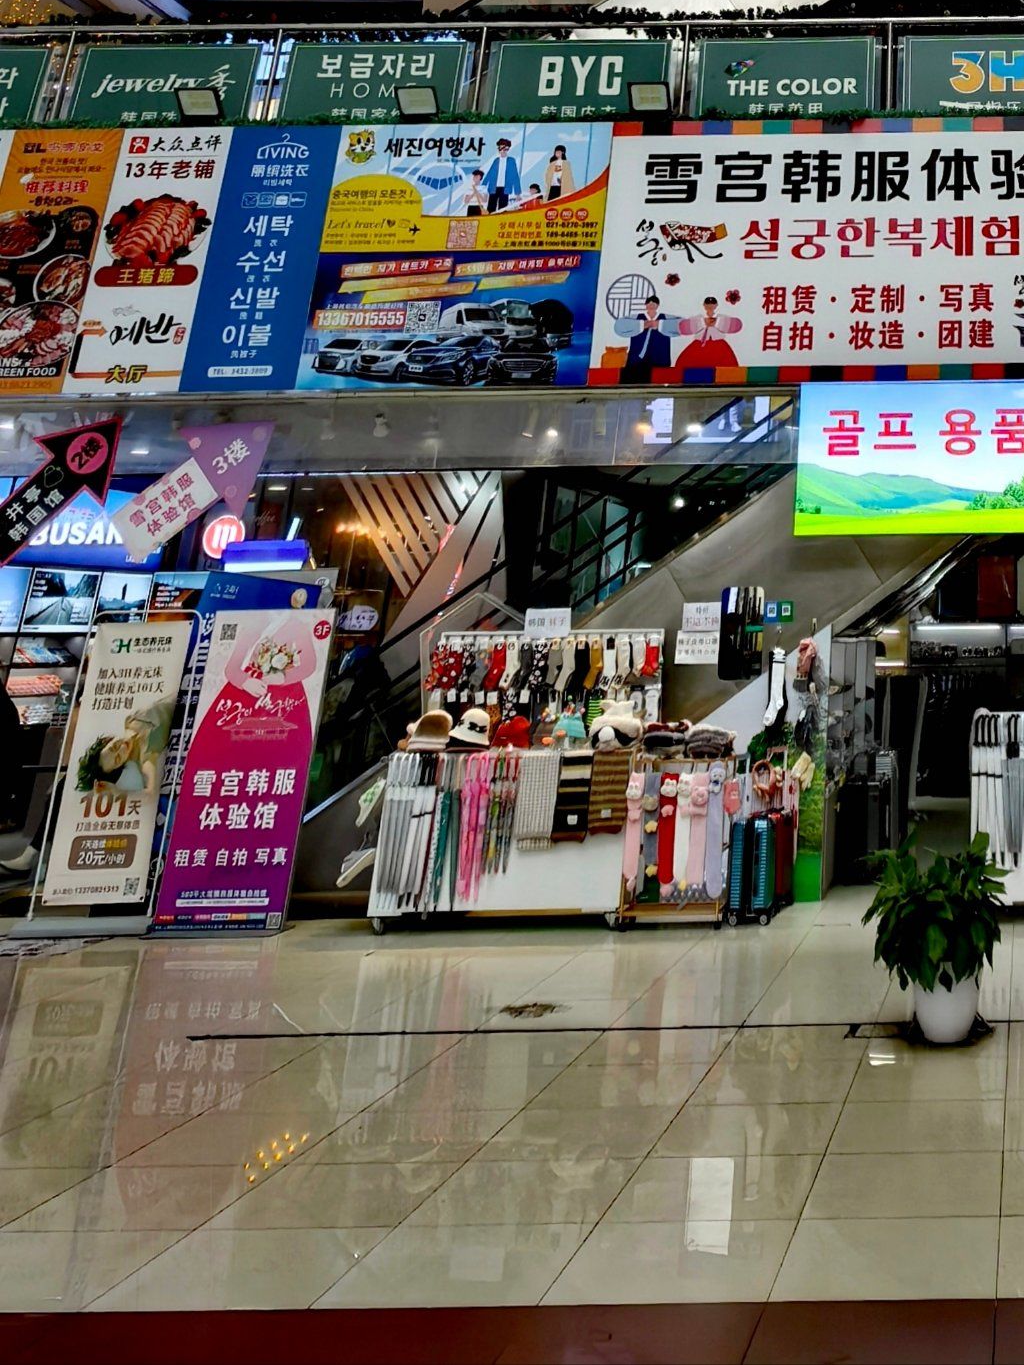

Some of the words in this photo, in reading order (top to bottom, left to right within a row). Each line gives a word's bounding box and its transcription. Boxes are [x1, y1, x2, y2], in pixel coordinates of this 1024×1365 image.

[317, 53, 435, 79] 보금자리
[538, 56, 623, 97] BYC
[330, 83, 418, 99] HOM
[727, 79, 769, 96] THE
[776, 77, 858, 95] COLOR
[150, 136, 222, 153] 大众点评
[257, 145, 309, 159] LIVING
[384, 136, 486, 158] 세진여행사
[125, 160, 215, 179] 13年老铺
[243, 215, 293, 236] 세탁
[236, 251, 286, 273] 수선
[117, 268, 175, 284] 王猪蹄
[230, 287, 280, 309] 신발
[762, 284, 817, 316] 租赁
[851, 284, 905, 315] 定制
[939, 283, 994, 313] 写真
[317, 311, 405, 326] 13367015555
[222, 324, 272, 346] 이불
[762, 321, 813, 352] 自拍
[848, 321, 905, 350] 妆造
[939, 320, 995, 349] 团建
[26, 368, 56, 376] FOOD
[105, 365, 148, 384] 大厅
[823, 410, 917, 456] 골프
[71, 437, 104, 470] 2楼
[212, 440, 250, 475] 3楼
[5, 487, 43, 520] 井亭
[129, 473, 194, 528] 雪宫韩服
[8, 489, 65, 541] 韩国馆
[147, 495, 196, 537] 体验馆
[315, 624, 330, 636] 3F
[193, 768, 296, 797] 雪宫韩服
[80, 793, 141, 818] 101天
[199, 802, 279, 830] 体验馆
[174, 848, 209, 867] 租赁
[215, 848, 248, 866] 自拍
[255, 847, 288, 865] 写真
